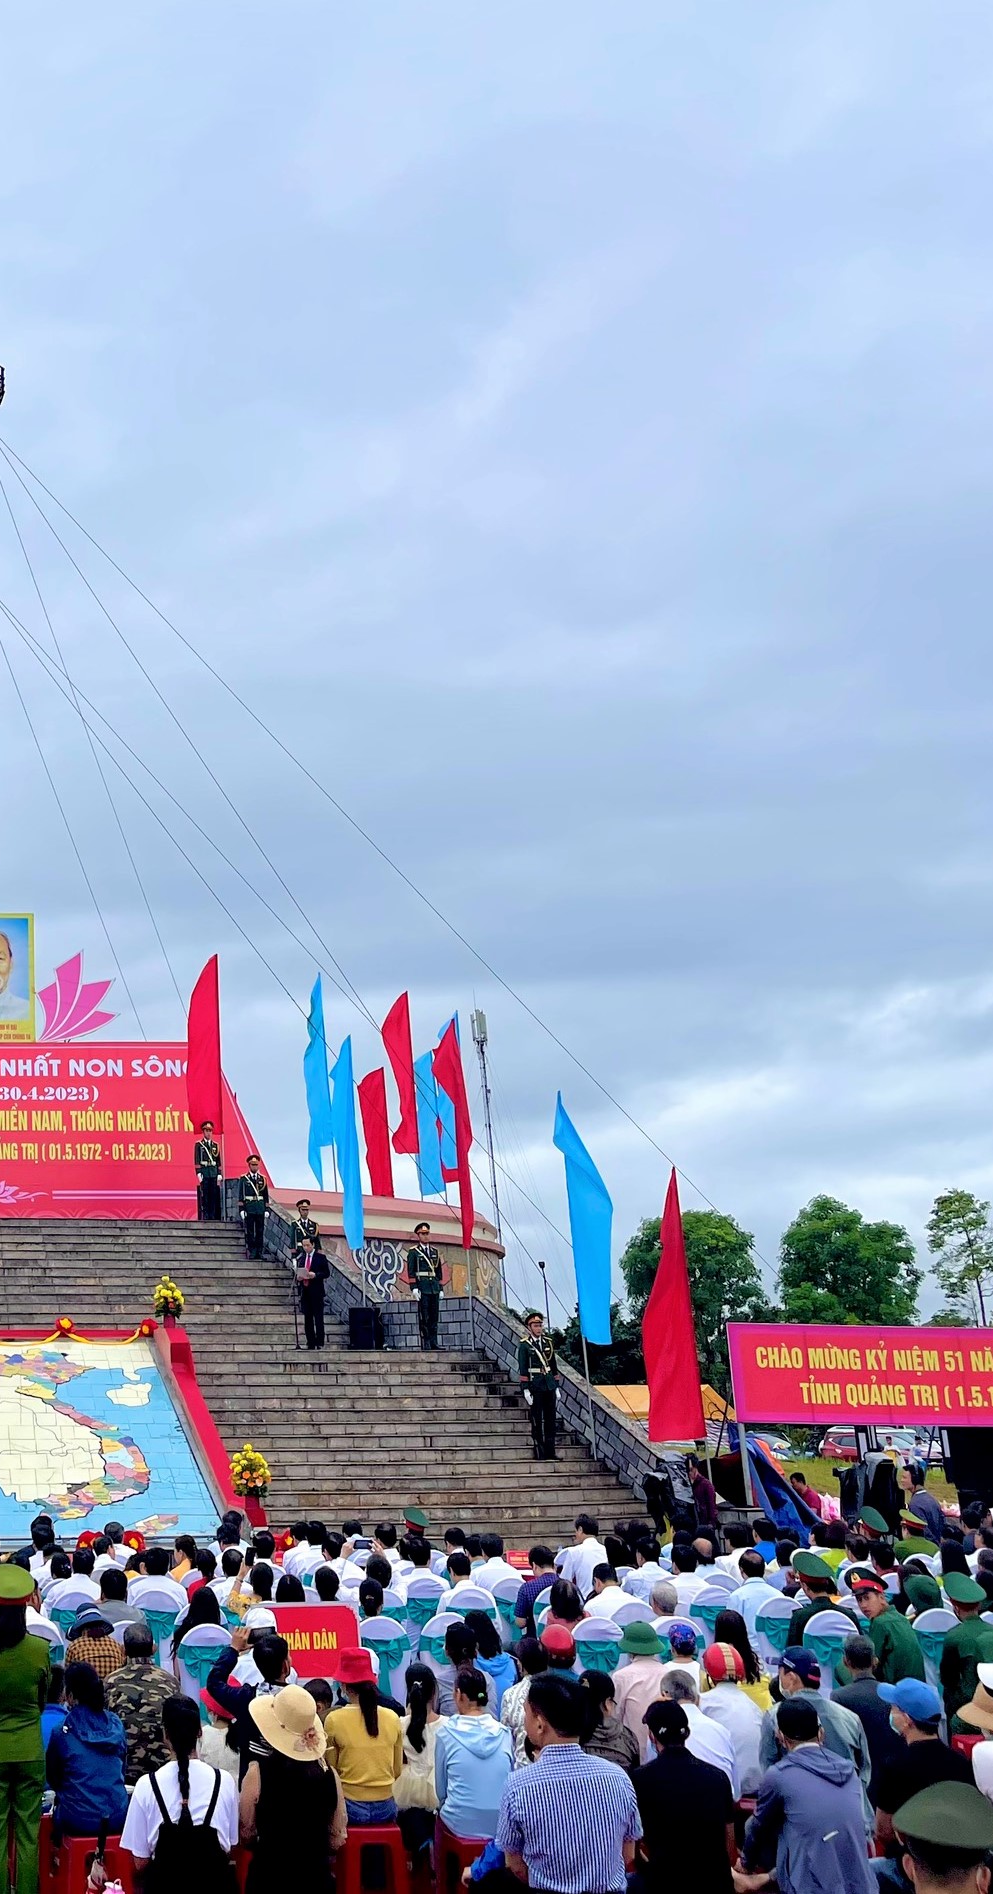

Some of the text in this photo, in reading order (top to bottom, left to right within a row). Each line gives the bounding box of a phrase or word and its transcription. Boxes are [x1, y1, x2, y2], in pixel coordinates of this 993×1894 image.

[0, 1052, 61, 1077] NHẤT
[69, 1059, 123, 1077] NON
[131, 1055, 188, 1077] SÔN
[32, 1110, 66, 1134] NAM,
[70, 1103, 113, 1132] THỐNG
[117, 1103, 151, 1132] NHẤT
[155, 1103, 179, 1132] ĐẤT
[21, 1143, 38, 1163] TRỊ
[755, 1343, 803, 1369] CHÀO
[808, 1343, 862, 1370] MỪNG
[865, 1341, 887, 1371] KỶ
[892, 1345, 940, 1376] NIỆM
[943, 1350, 964, 1372] 51
[799, 1375, 841, 1405] TỈNH
[845, 1375, 907, 1408] QUẢNG
[910, 1384, 940, 1411] TRỊ
[313, 1628, 337, 1650] DÂN
